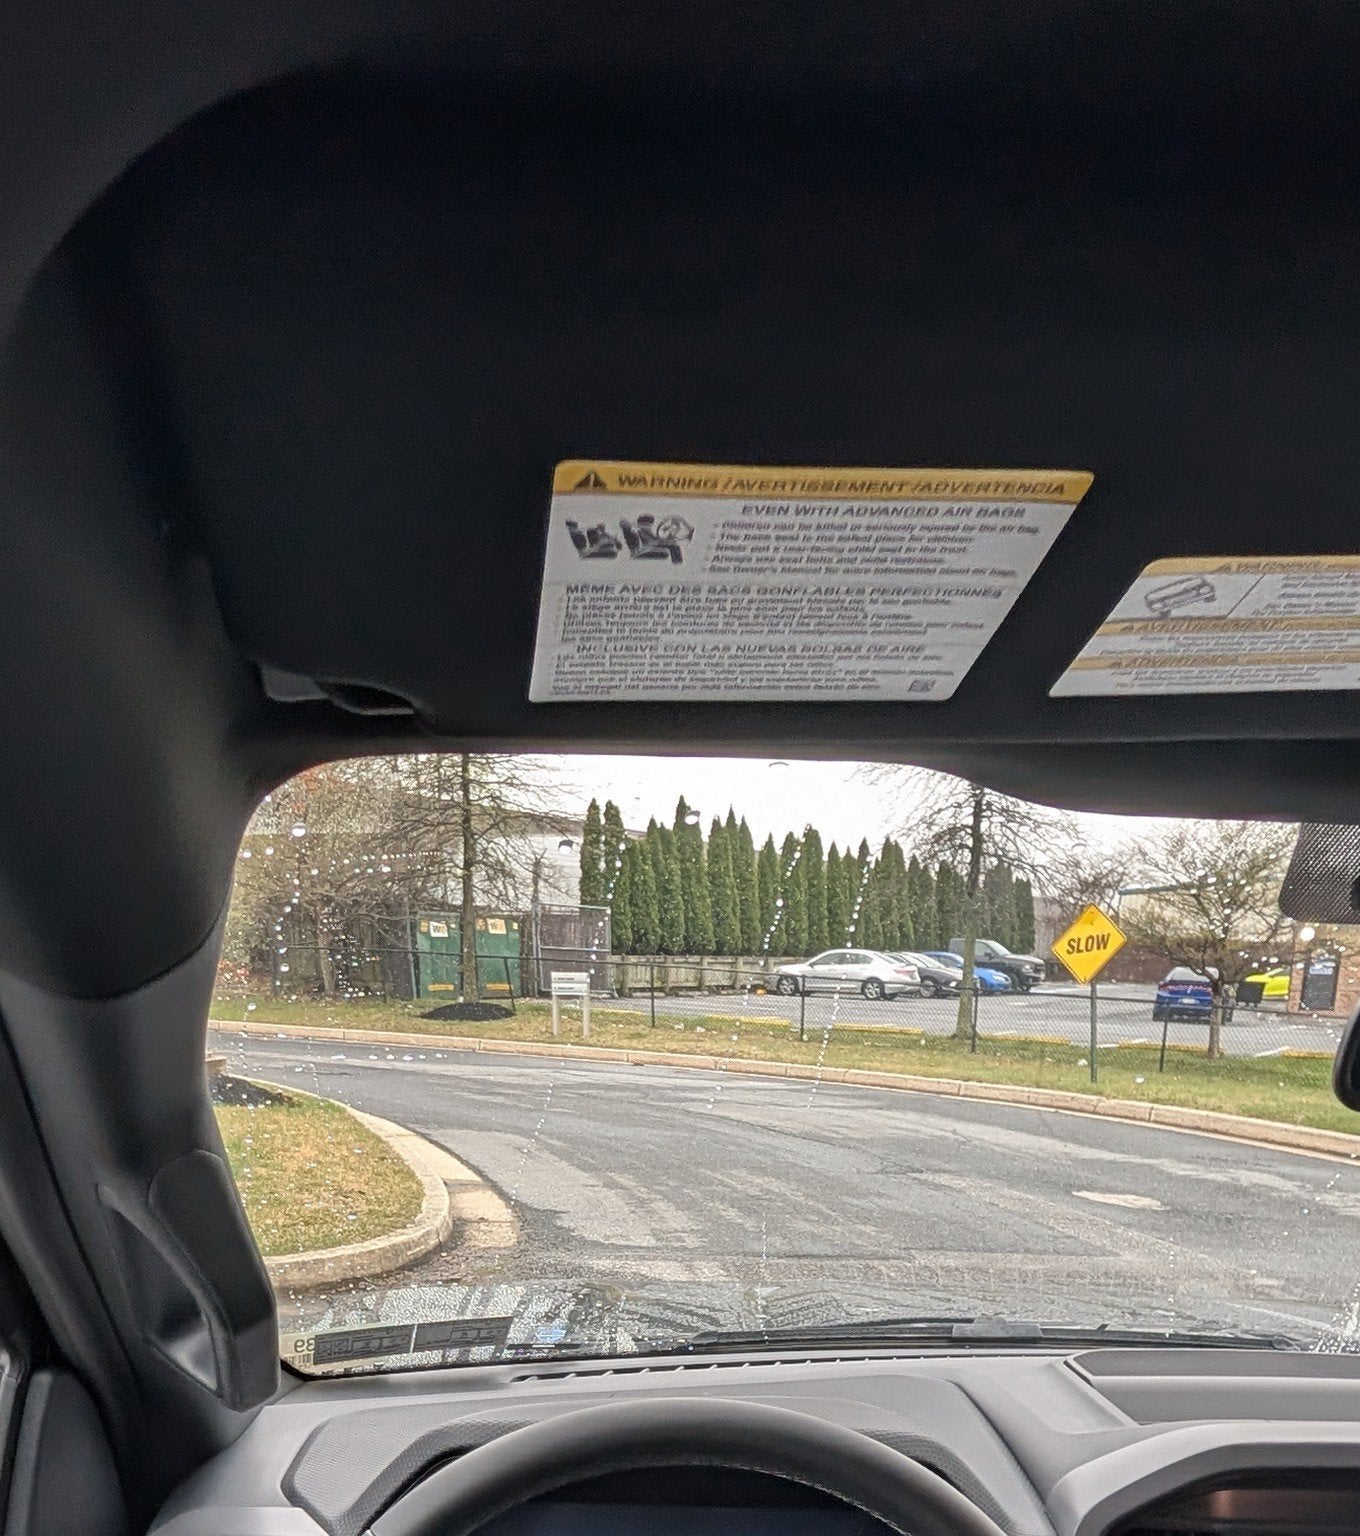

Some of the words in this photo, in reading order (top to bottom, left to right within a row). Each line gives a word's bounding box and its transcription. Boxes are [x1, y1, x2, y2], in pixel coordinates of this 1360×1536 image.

[741, 504, 790, 516] EVEN
[794, 505, 839, 517] WITH
[842, 506, 939, 518] ADVANCED
[1066, 933, 1111, 955] SLOW
